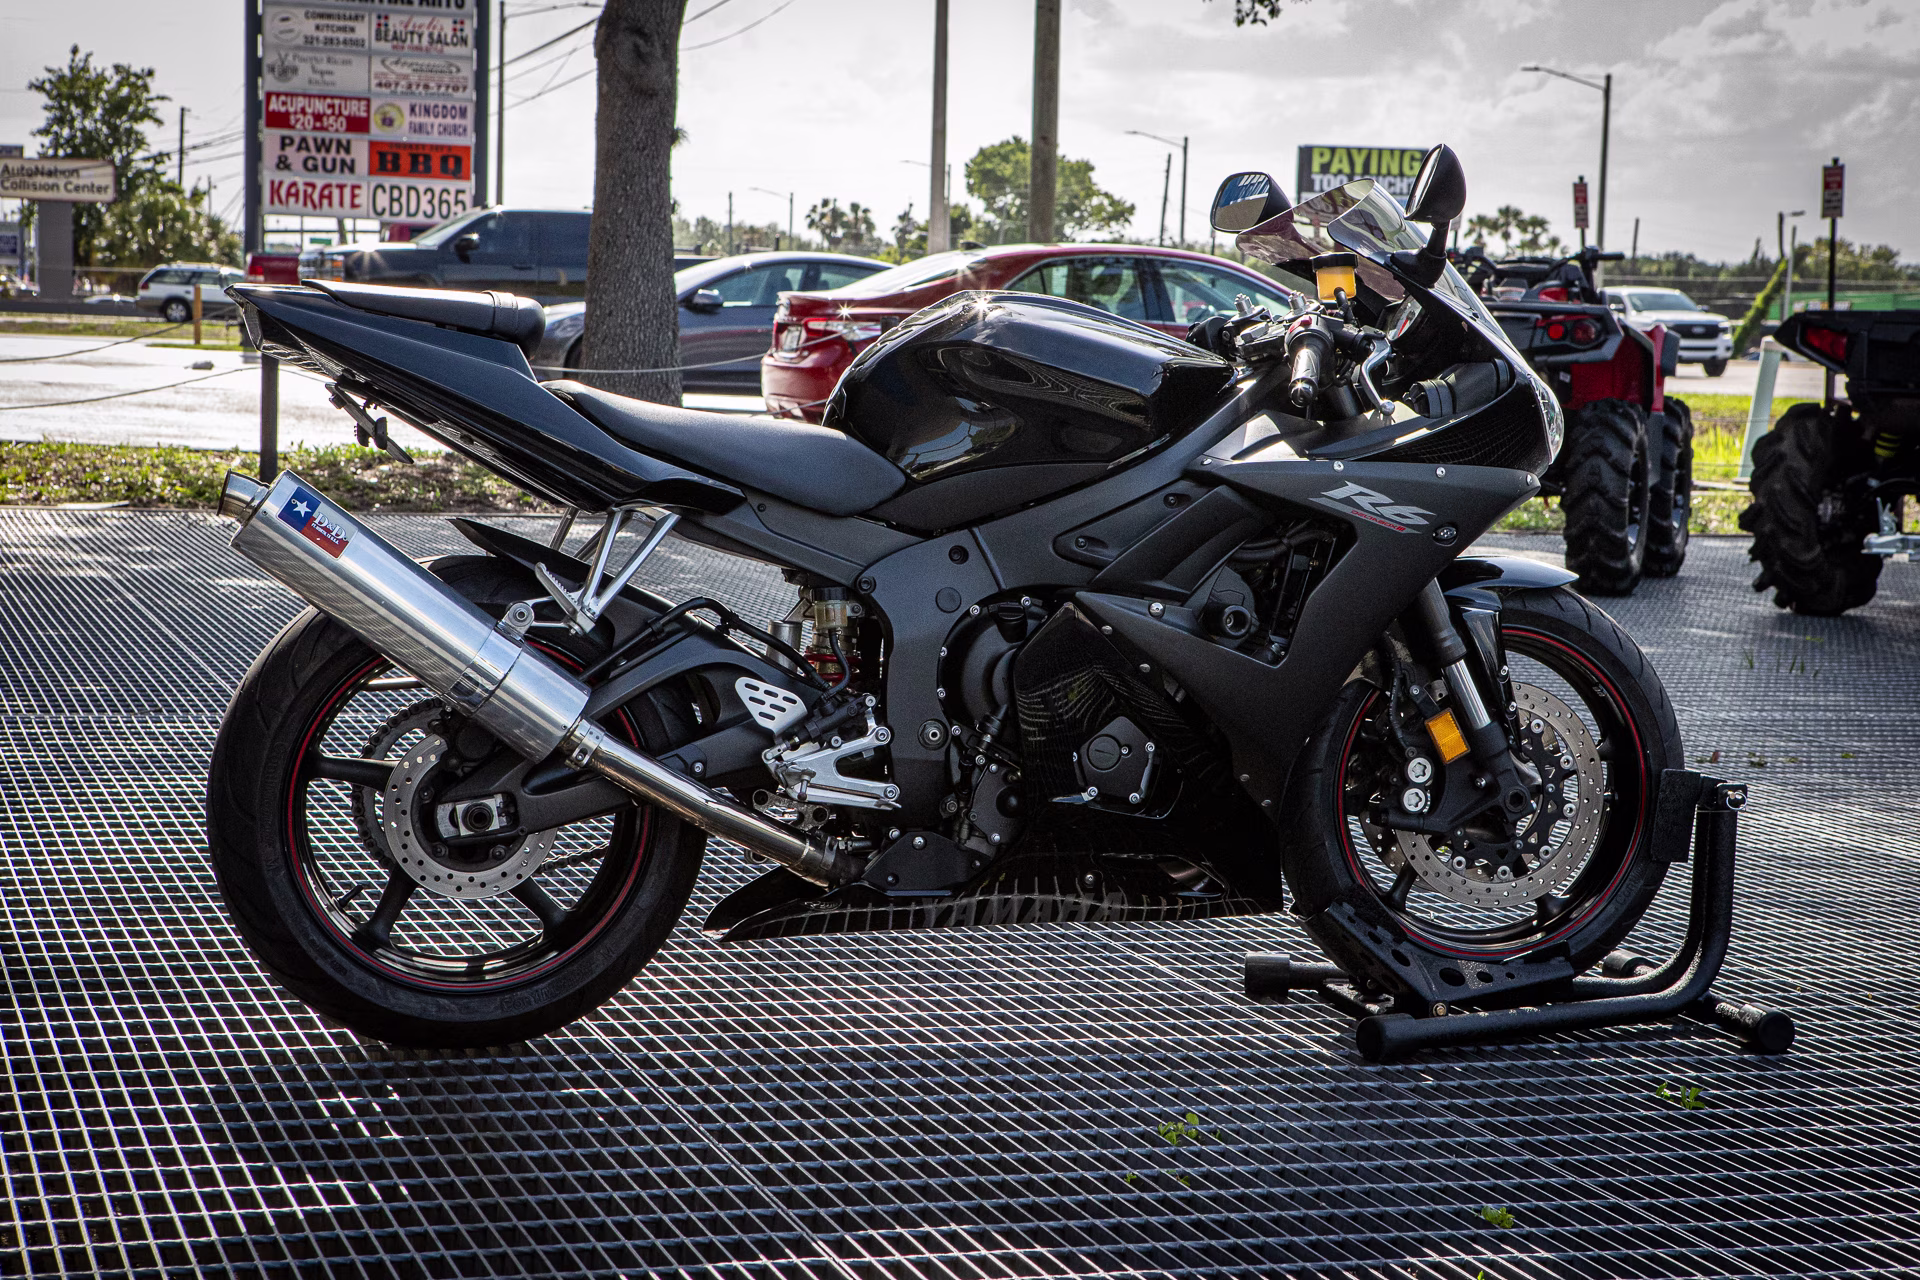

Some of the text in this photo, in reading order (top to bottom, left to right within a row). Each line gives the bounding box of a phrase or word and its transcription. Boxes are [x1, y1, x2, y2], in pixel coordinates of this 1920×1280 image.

[304, 10, 366, 23] COMMISSARY
[314, 24, 356, 34] KITCHEN
[375, 28, 469, 47] BEAUTY SALON
[268, 95, 369, 117] ACUPUNCTURE
[409, 102, 468, 119] KINGDOM
[409, 121, 468, 137] FAMILY CHURCH
[280, 135, 352, 155] PAWN
[275, 154, 356, 175] & GUN
[376, 151, 466, 179] BBQ
[1310, 147, 1422, 176] PAYING
[0, 179, 110, 195] Collision Center
[1311, 174, 1349, 193] TOO
[269, 179, 363, 211] KARATE
[371, 183, 467, 220] CBD365
[1320, 480, 1437, 525] R6
[313, 512, 347, 539] D&D
[919, 892, 1124, 928] YAMAHA
